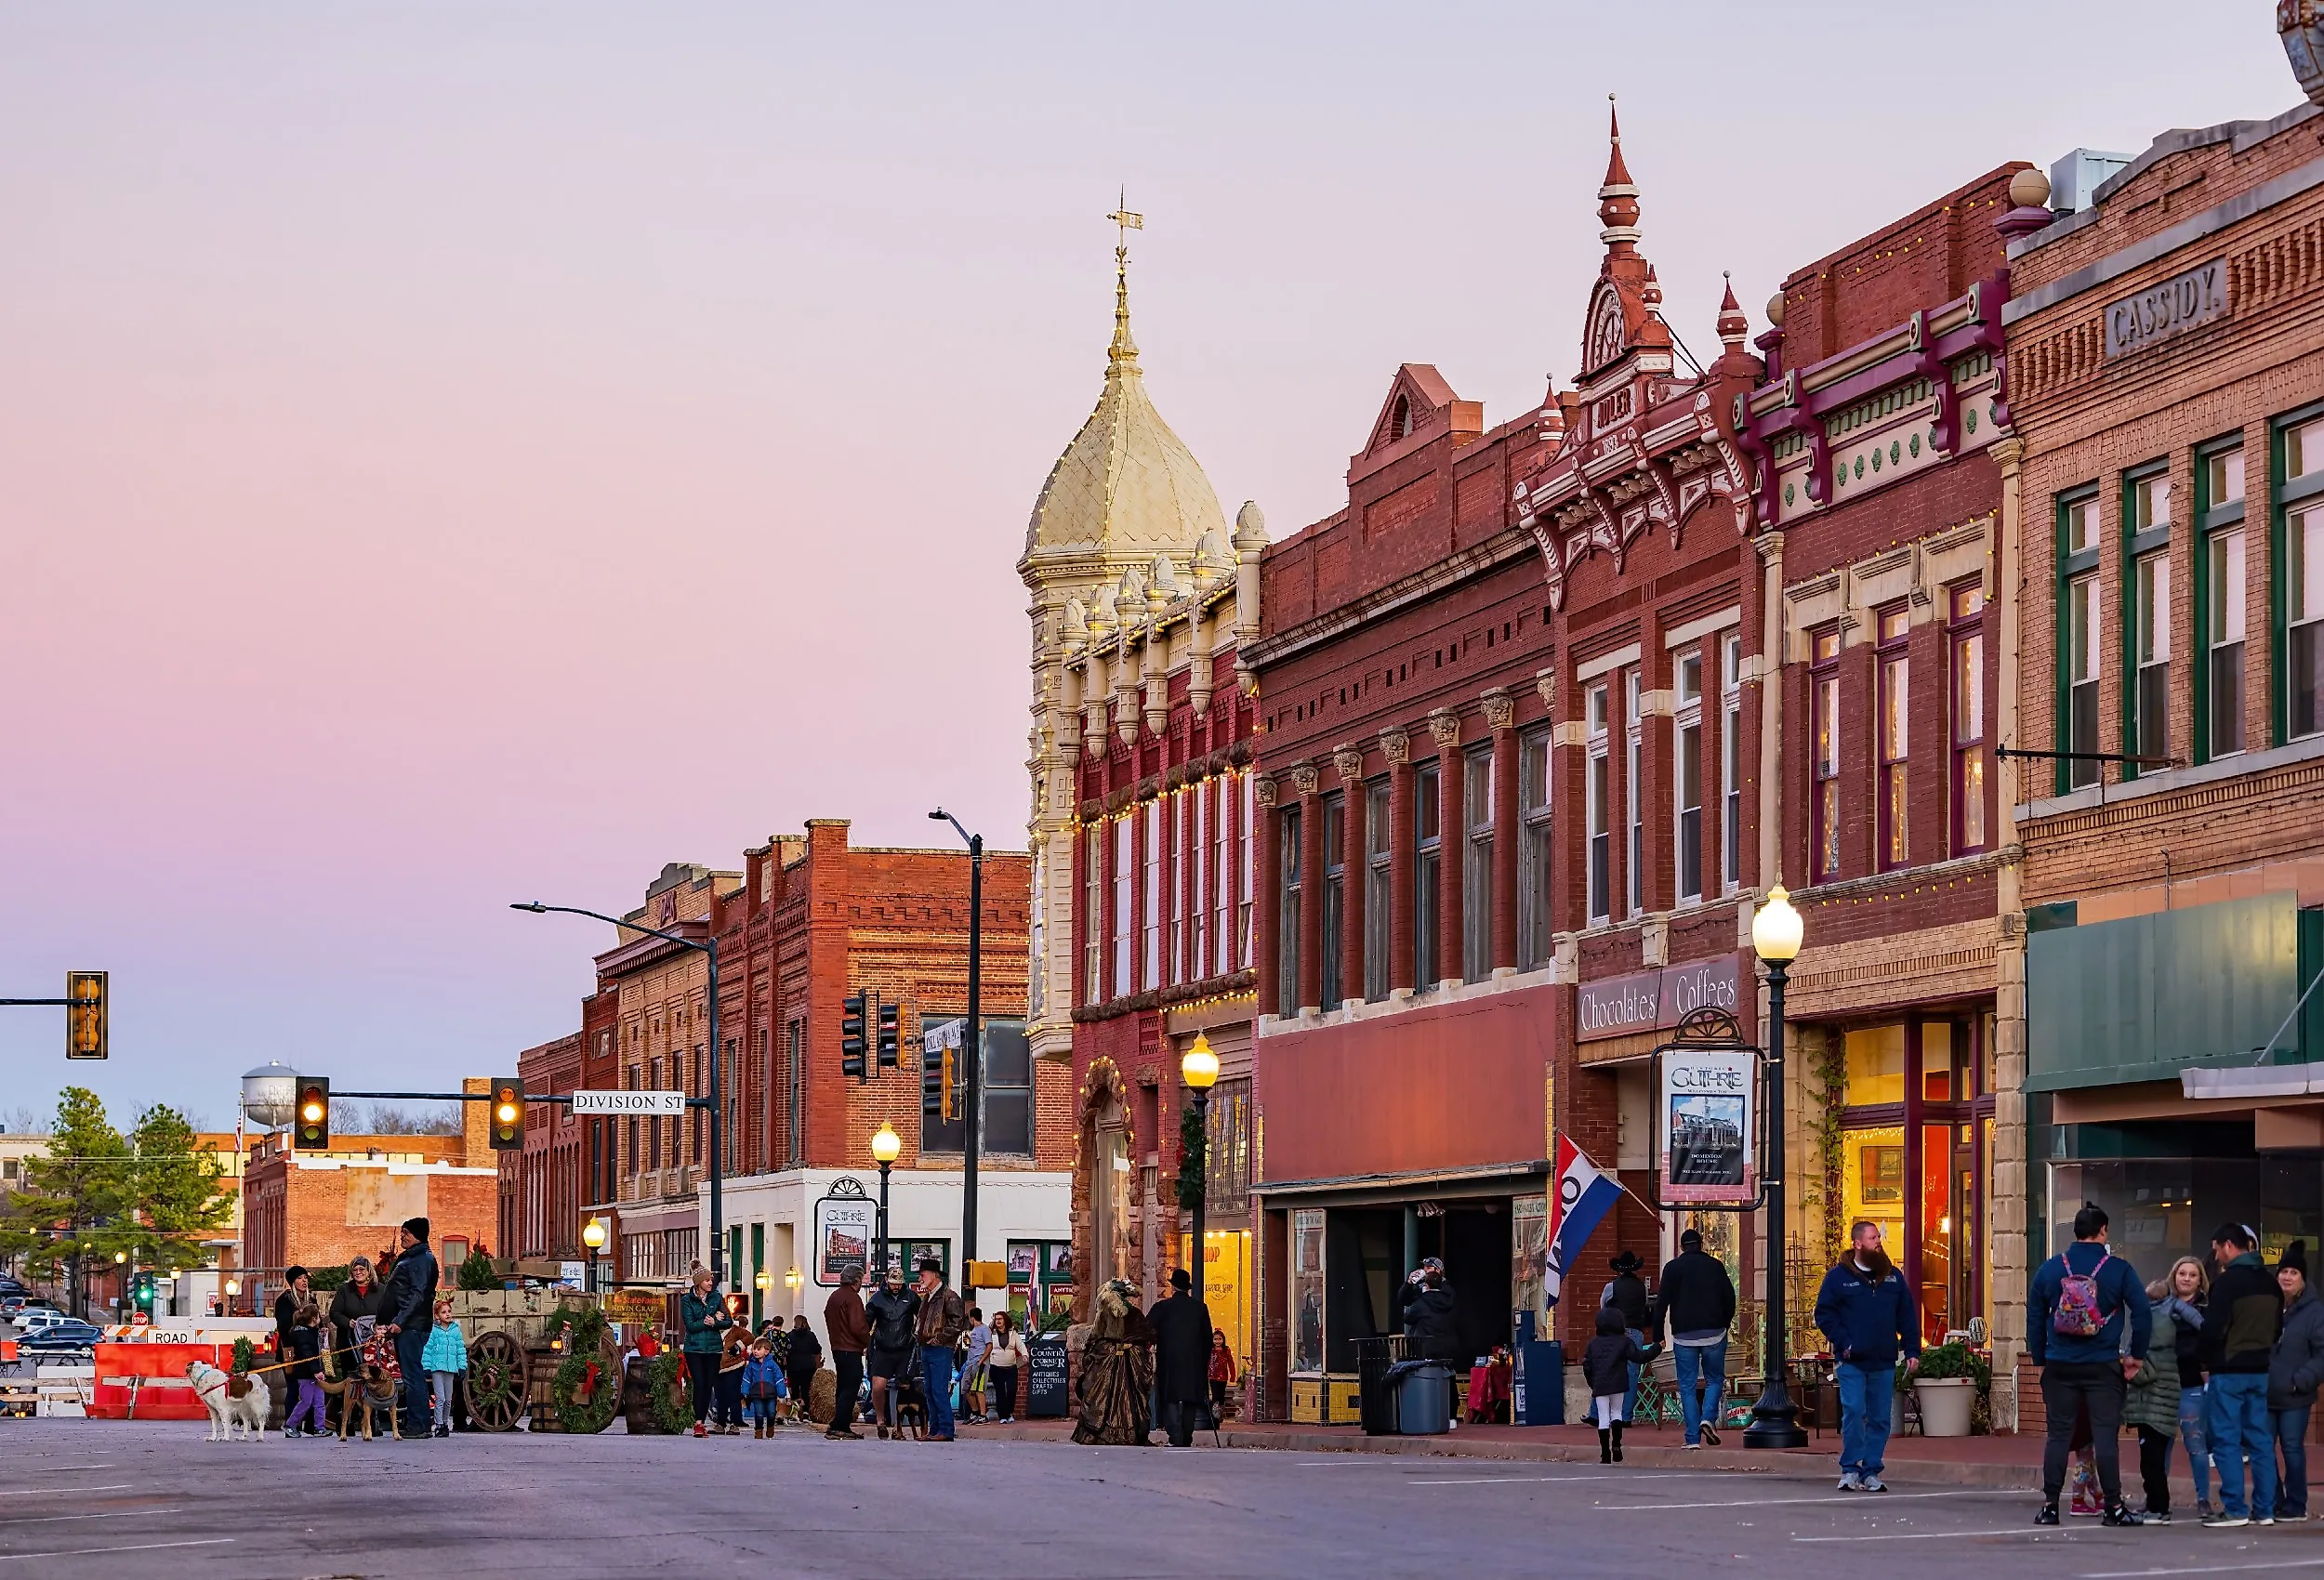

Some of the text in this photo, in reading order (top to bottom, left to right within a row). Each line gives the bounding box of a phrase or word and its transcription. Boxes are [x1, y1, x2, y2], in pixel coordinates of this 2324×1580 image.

[1581, 968, 1735, 1031] Chocolates Coffees
[574, 1096, 683, 1109] DIVISION ST
[133, 1316, 147, 1324] STOP
[156, 1333, 188, 1344] ROAD
[1031, 1347, 1067, 1357] COUNTRY
[1032, 1358, 1065, 1368] CORNER
